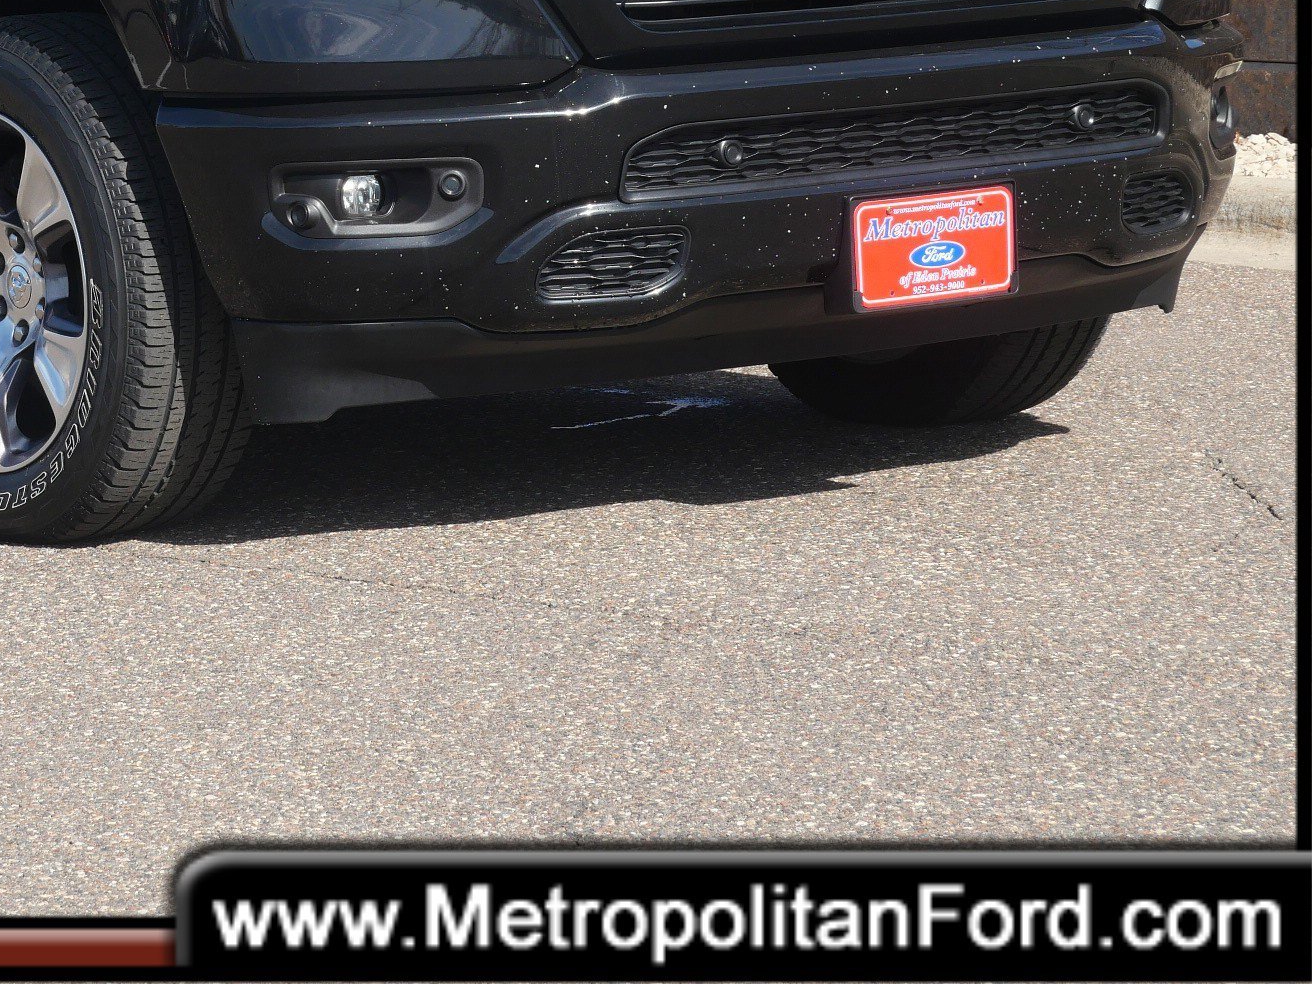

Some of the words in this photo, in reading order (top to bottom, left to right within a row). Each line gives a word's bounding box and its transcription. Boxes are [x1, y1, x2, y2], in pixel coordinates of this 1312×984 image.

[864, 208, 1005, 242] Metropolitan
[922, 246, 954, 263] Ford
[899, 272, 913, 288] of
[912, 270, 939, 284] Eden
[940, 264, 976, 280] Prairie
